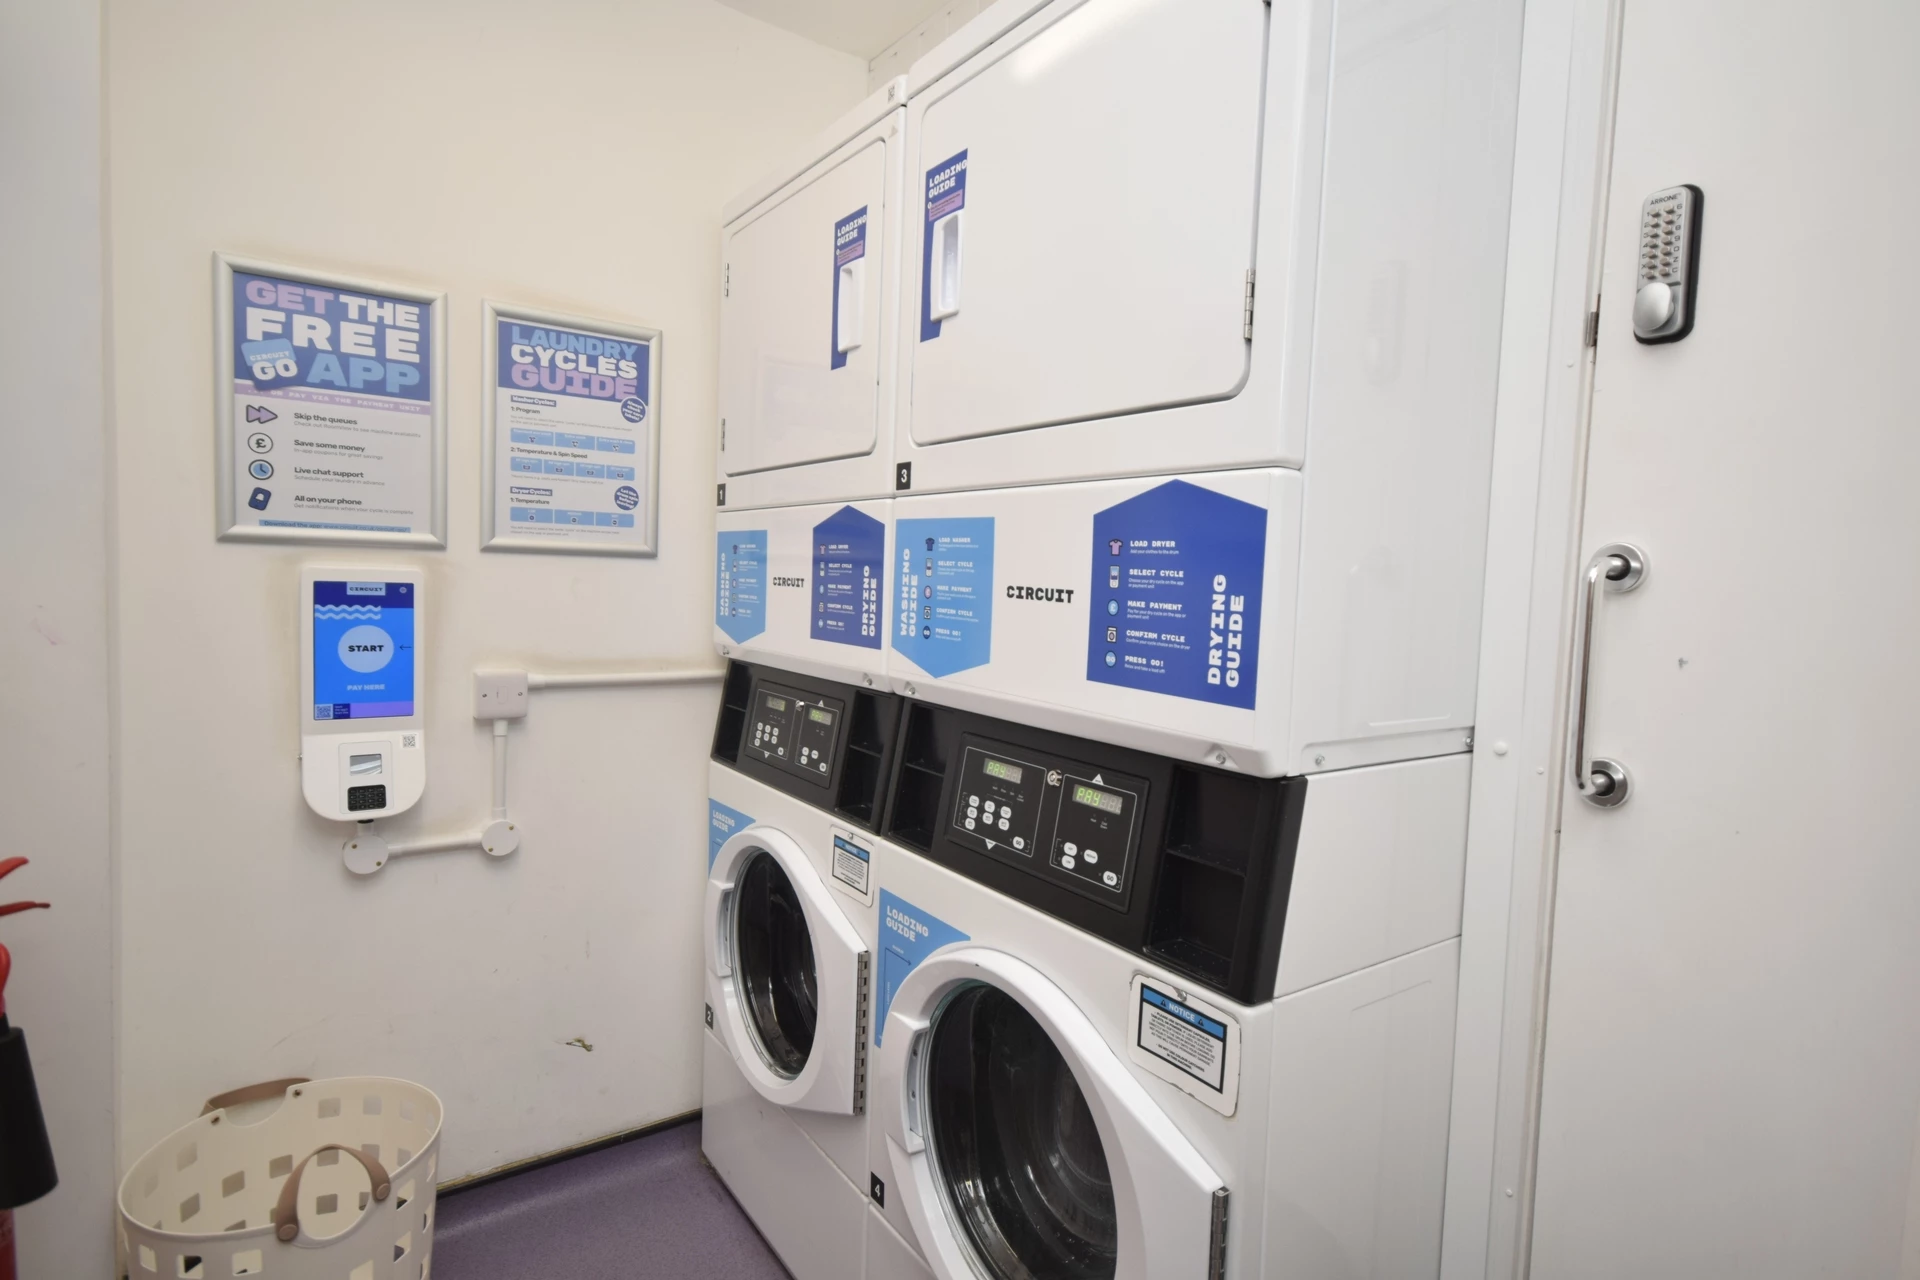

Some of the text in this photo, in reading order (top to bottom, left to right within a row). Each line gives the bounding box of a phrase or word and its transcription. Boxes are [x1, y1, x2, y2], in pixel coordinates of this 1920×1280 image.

[929, 159, 967, 188] LOADING
[929, 176, 956, 198] GUIDE
[1650, 195, 1677, 205] ARRONE
[838, 214, 867, 236] LOADING
[837, 228, 858, 246] GUIDE
[246, 280, 420, 329] GET THE
[246, 307, 420, 363] FREE
[512, 326, 638, 360] LAUNDRY
[250, 351, 289, 362] CIRCUIT
[511, 344, 637, 379] CYCLES
[252, 358, 298, 380] GO
[306, 352, 420, 393] APP
[511, 363, 637, 399] GUIDE
[357, 400, 394, 408] PAYMENT
[294, 412, 312, 421] Skip
[255, 438, 267, 449] £
[338, 444, 365, 452] money
[516, 447, 552, 456] Temperature
[312, 468, 331, 476] chat
[332, 470, 364, 478] support
[901, 469, 907, 483] 3
[719, 490, 723, 500] 1
[773, 576, 804, 588] CIRCUIT
[900, 549, 910, 636] WASHING
[1006, 585, 1074, 603] CIRCUIT
[909, 575, 918, 636] GUIDE
[1150, 602, 1182, 610] PAYMENT
[1126, 630, 1185, 642] CONFIRM CYCLE
[1208, 574, 1227, 685] DRYING
[1226, 595, 1244, 688] GUIDE
[1125, 655, 1146, 664] PRESS
[987, 761, 1006, 778] PAY
[1076, 787, 1100, 806] PAY
[712, 818, 728, 833] GUIDE
[713, 810, 735, 827] LOADING
[886, 905, 929, 937] LOADING
[886, 917, 916, 942] GUIDE
[708, 1010, 711, 1022] 2
[1169, 1003, 1196, 1022] NOTICE
[875, 1184, 880, 1197] 4
